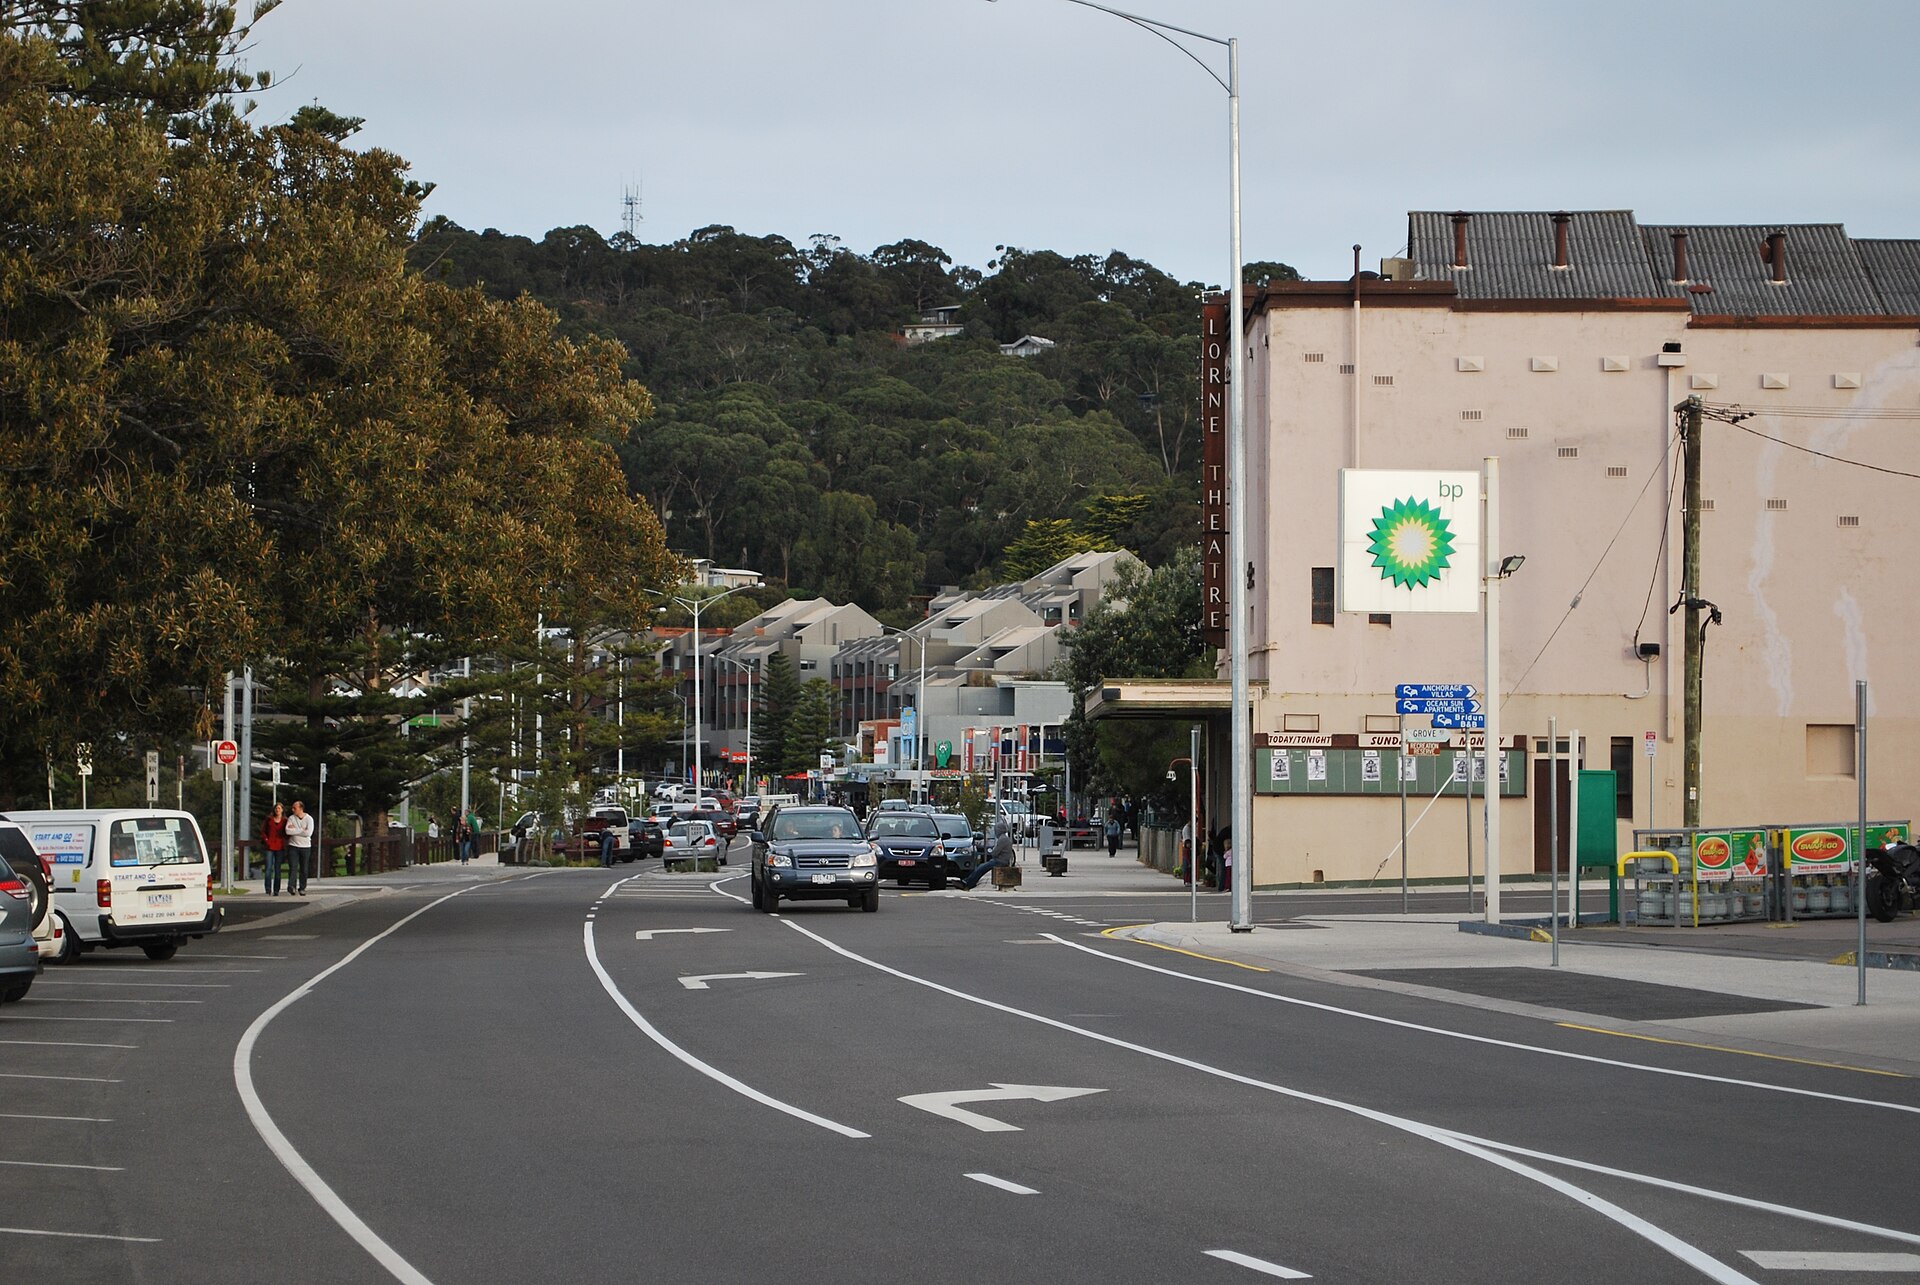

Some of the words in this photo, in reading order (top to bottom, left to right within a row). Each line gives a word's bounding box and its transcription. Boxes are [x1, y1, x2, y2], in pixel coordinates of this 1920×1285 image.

[1208, 318, 1221, 434] LORNE
[1439, 479, 1463, 502] bp
[1208, 465, 1221, 628] THEATRE
[1421, 684, 1463, 692] ANCHORAGE
[1412, 729, 1437, 738] GROVE
[1268, 735, 1331, 744] TODAY/TONIGHT
[34, 833, 52, 841] START
[114, 873, 133, 881] START
